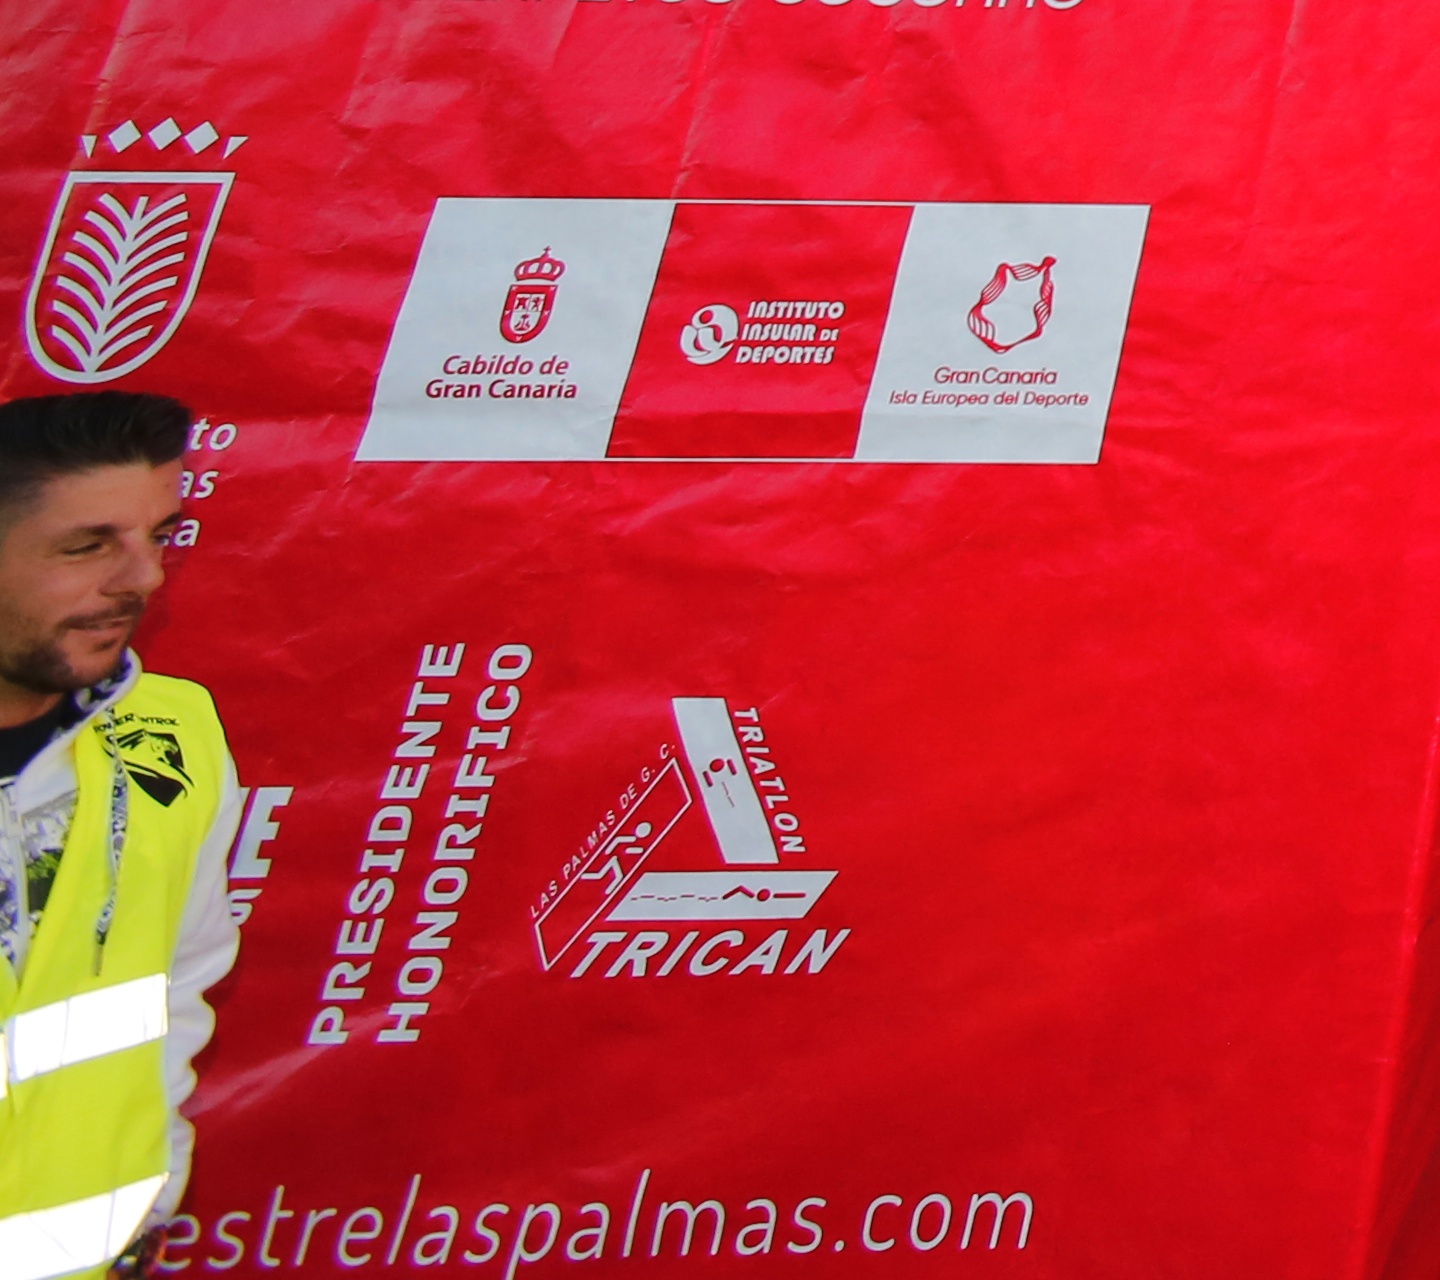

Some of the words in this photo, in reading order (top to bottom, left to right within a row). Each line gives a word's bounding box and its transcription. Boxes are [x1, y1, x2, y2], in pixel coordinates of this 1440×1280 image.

[747, 298, 846, 321] INSTITUTO
[741, 322, 815, 343] INSULAR
[819, 327, 839, 343] DE
[442, 353, 540, 377] Cabildo
[545, 354, 570, 377] de
[735, 344, 834, 366] DEPORTES
[425, 377, 483, 401] Gran
[488, 377, 577, 402] Canaria
[888, 388, 918, 408] Isla
[922, 389, 989, 411] Europea
[994, 389, 1017, 408] del
[1022, 389, 1089, 411] Deporte
[736, 707, 808, 855] TRIATLON
[308, 642, 466, 1047] PRESIDENTE
[529, 876, 561, 917] LAS
[560, 806, 620, 881] PALMAS
[619, 782, 643, 809] DE
[570, 928, 850, 979] TRICAN
[160, 1173, 1036, 1280] estrelaspalmas.com
